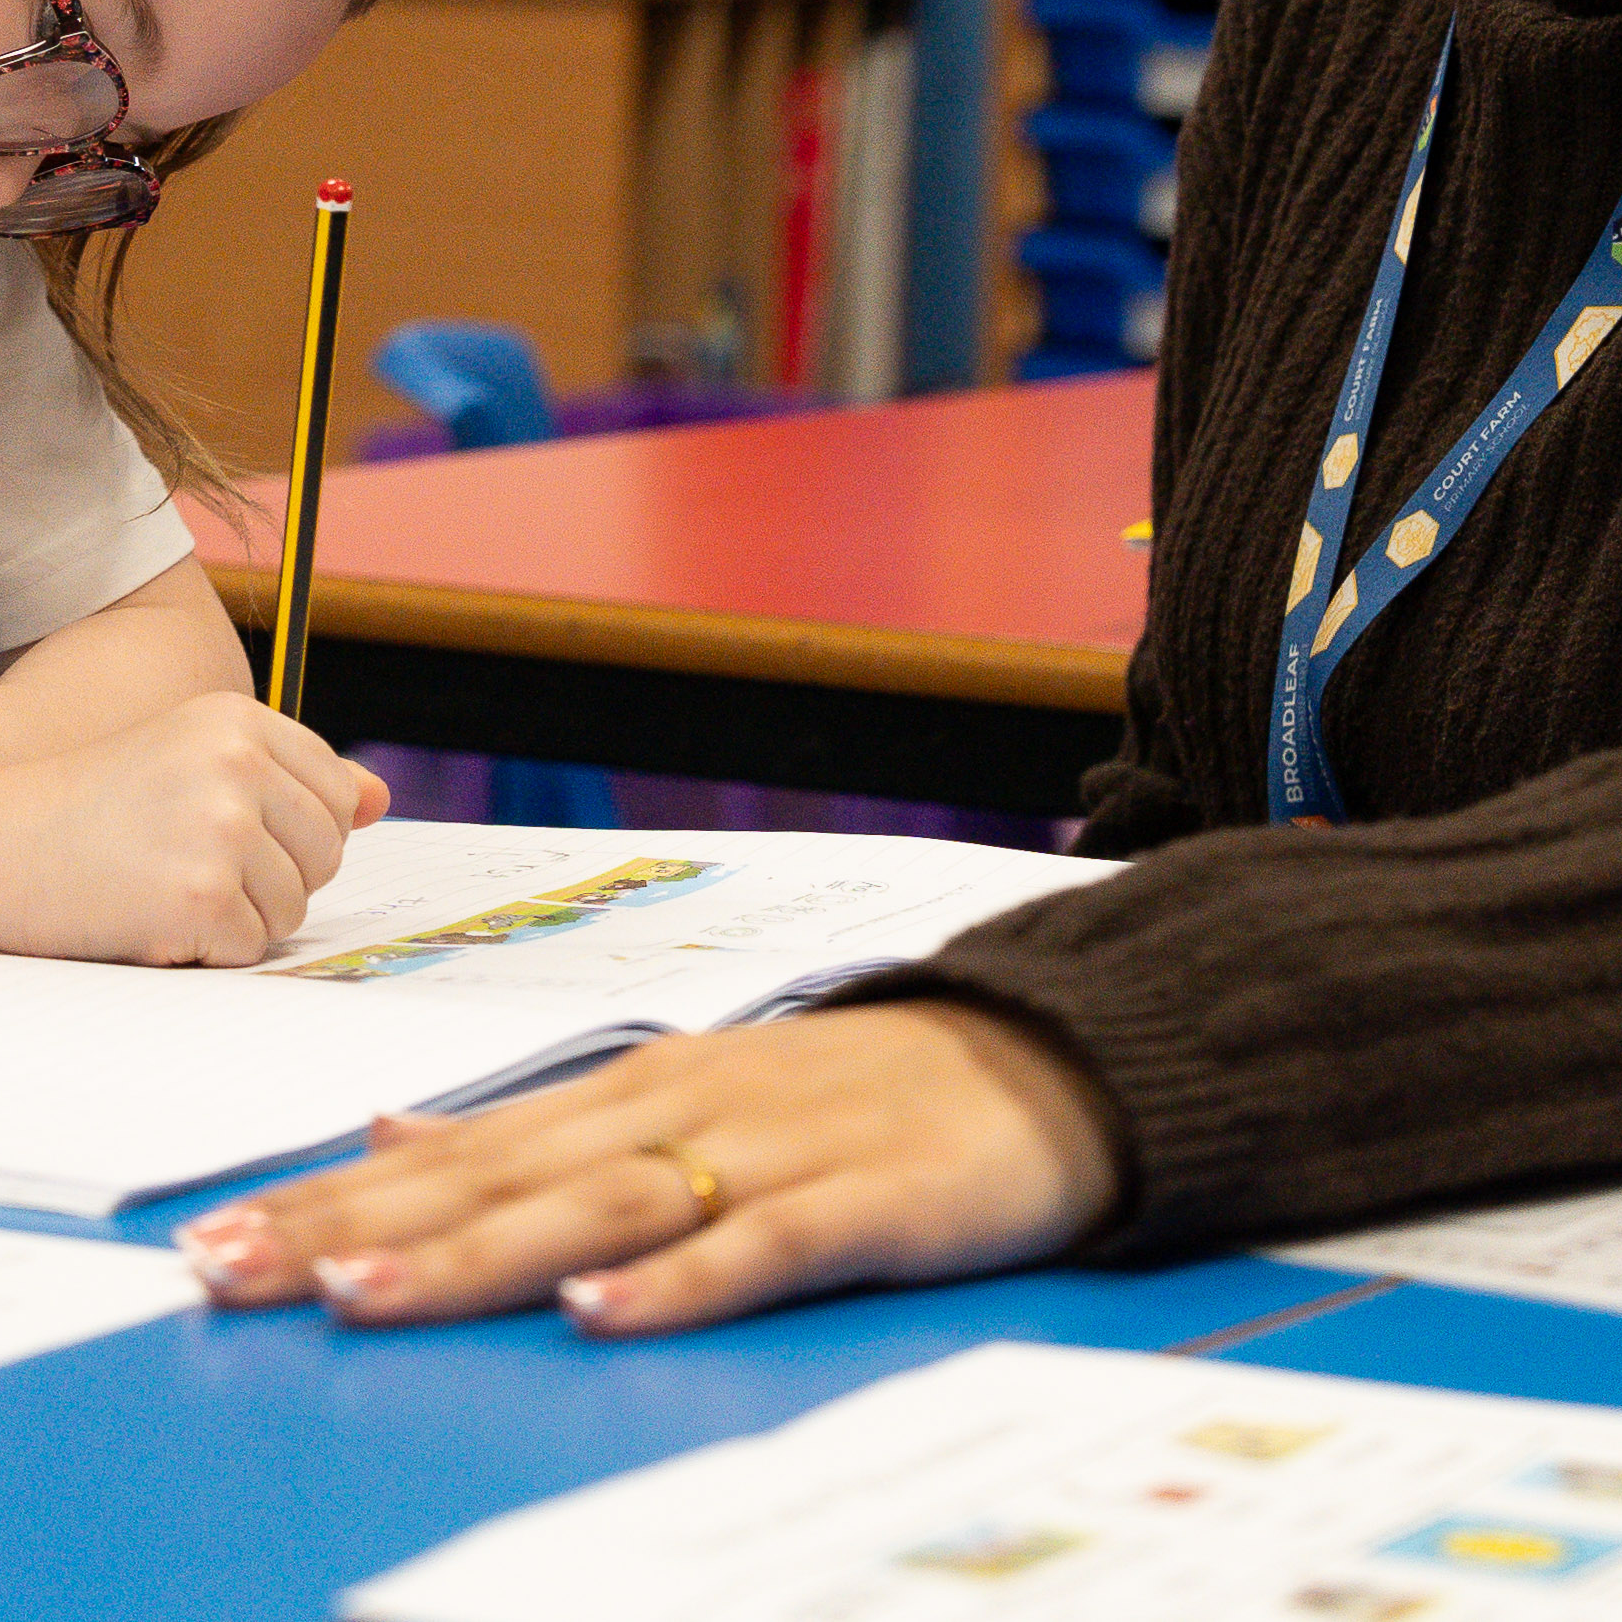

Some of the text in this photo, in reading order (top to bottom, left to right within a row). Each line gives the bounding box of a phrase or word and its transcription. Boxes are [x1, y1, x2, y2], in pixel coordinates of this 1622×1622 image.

[1343, 357, 1366, 422] COURT
[1433, 391, 1522, 501] COURT FARM
[1444, 403, 1531, 512] PRIMARY SCHOOL
[1282, 642, 1304, 803] BROADLEAF
